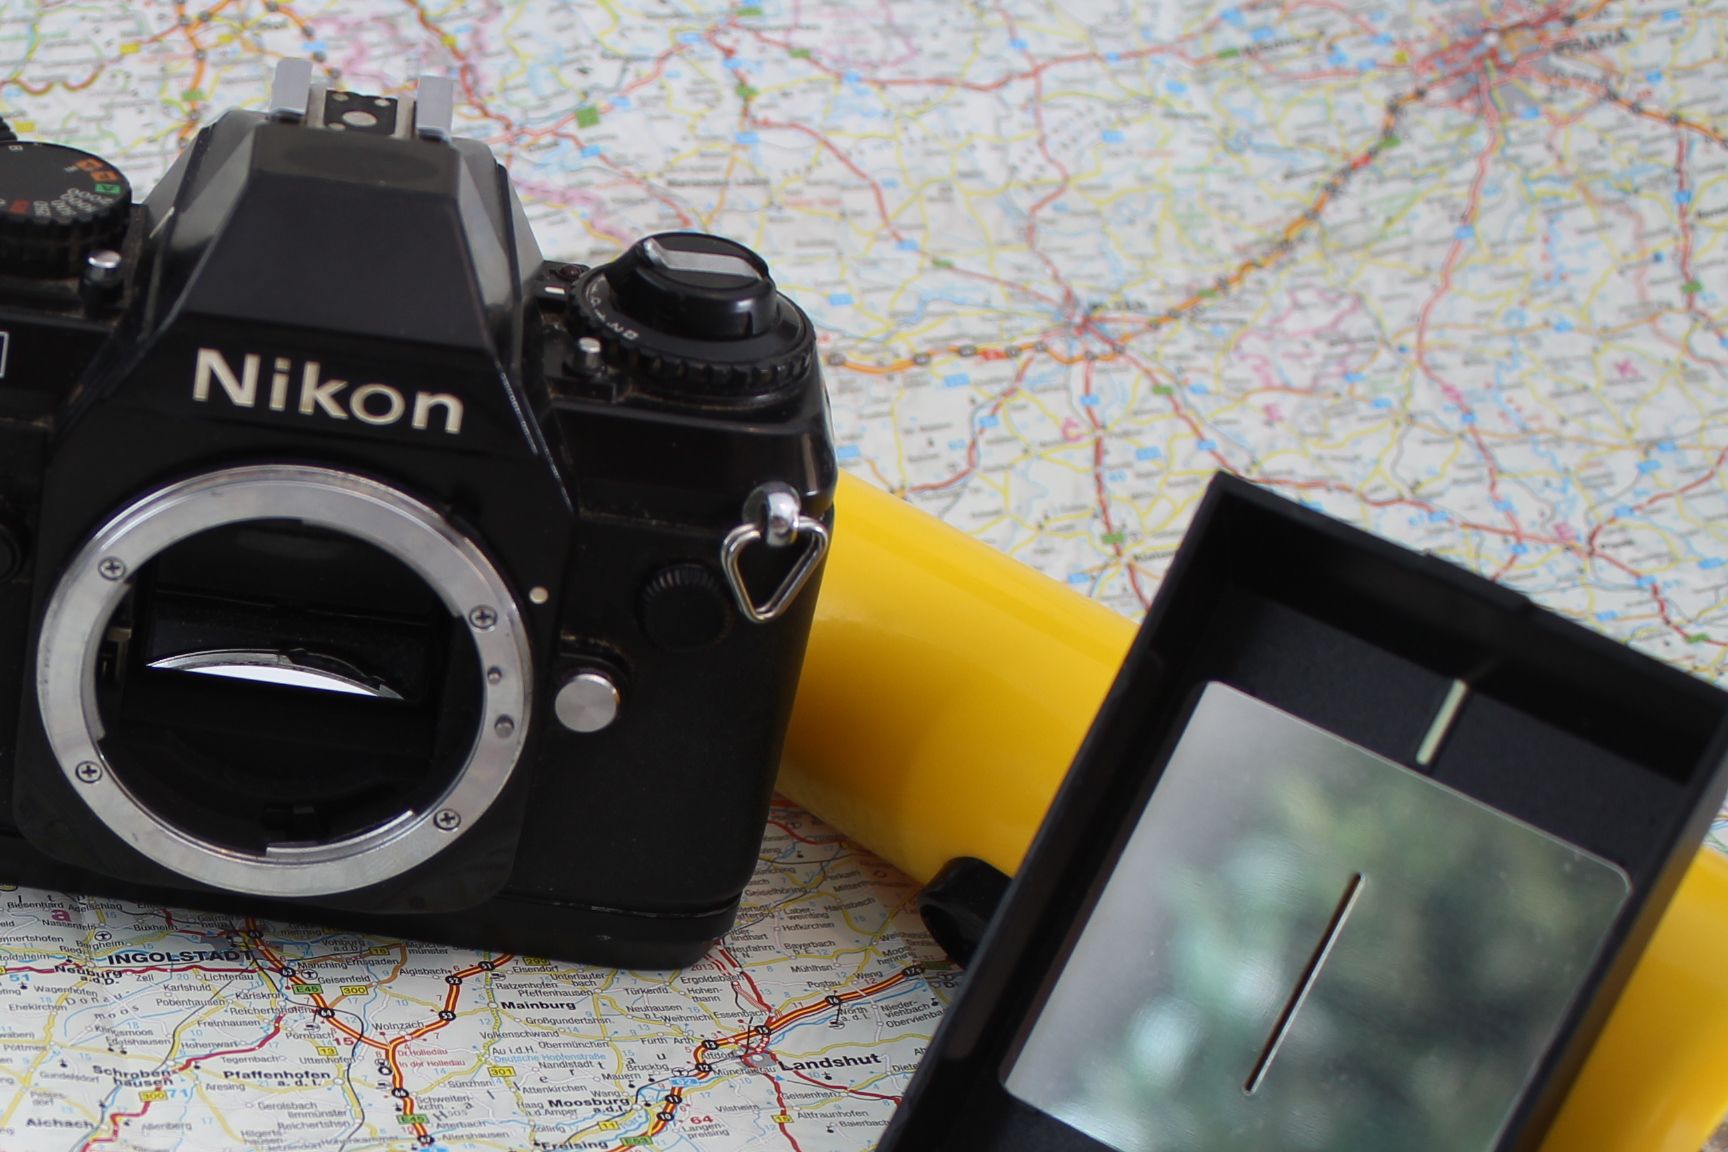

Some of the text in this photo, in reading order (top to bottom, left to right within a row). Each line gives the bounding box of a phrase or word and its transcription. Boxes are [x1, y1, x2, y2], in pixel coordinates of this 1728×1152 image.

[192, 347, 464, 434] Nikon
[106, 949, 252, 967] INGOLSTADT
[778, 1054, 881, 1071] Landshut
